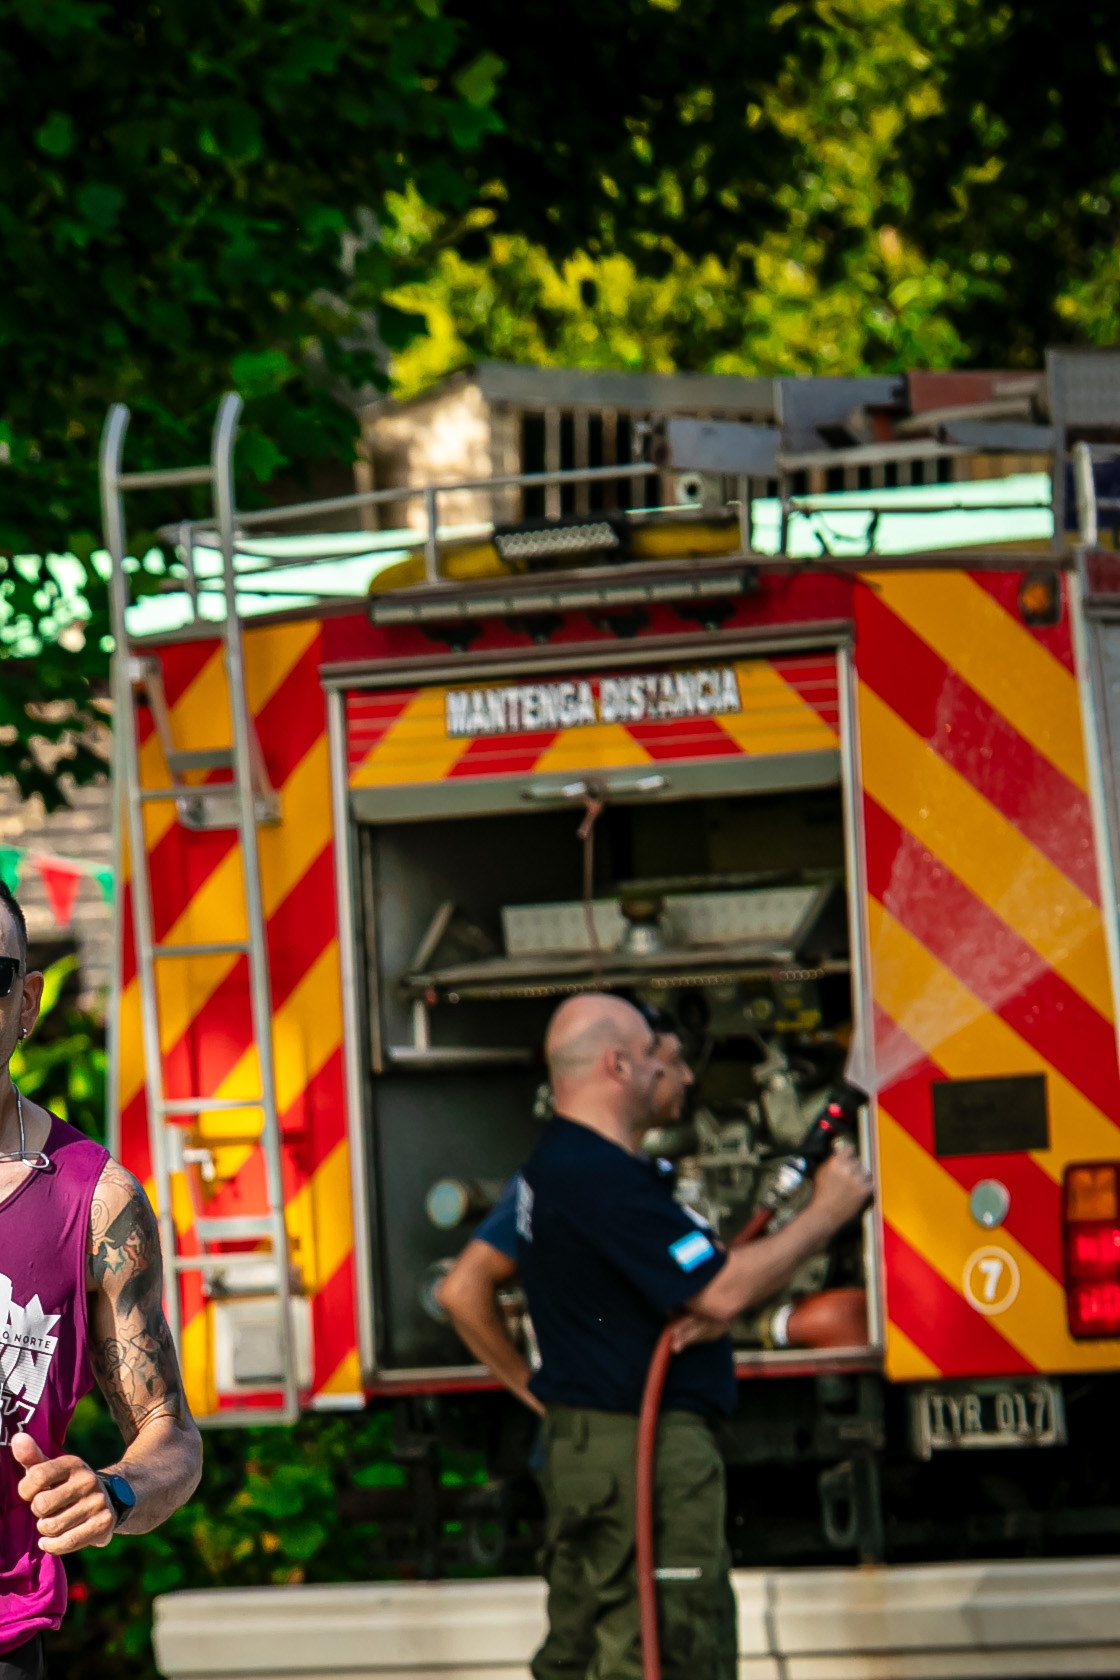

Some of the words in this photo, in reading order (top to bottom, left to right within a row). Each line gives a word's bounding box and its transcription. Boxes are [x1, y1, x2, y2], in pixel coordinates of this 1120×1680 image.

[447, 681, 596, 737] MANTENGA
[599, 668, 742, 722] DISTANCIA
[979, 1258, 1003, 1301] 7
[14, 1333, 52, 1350] NORTE
